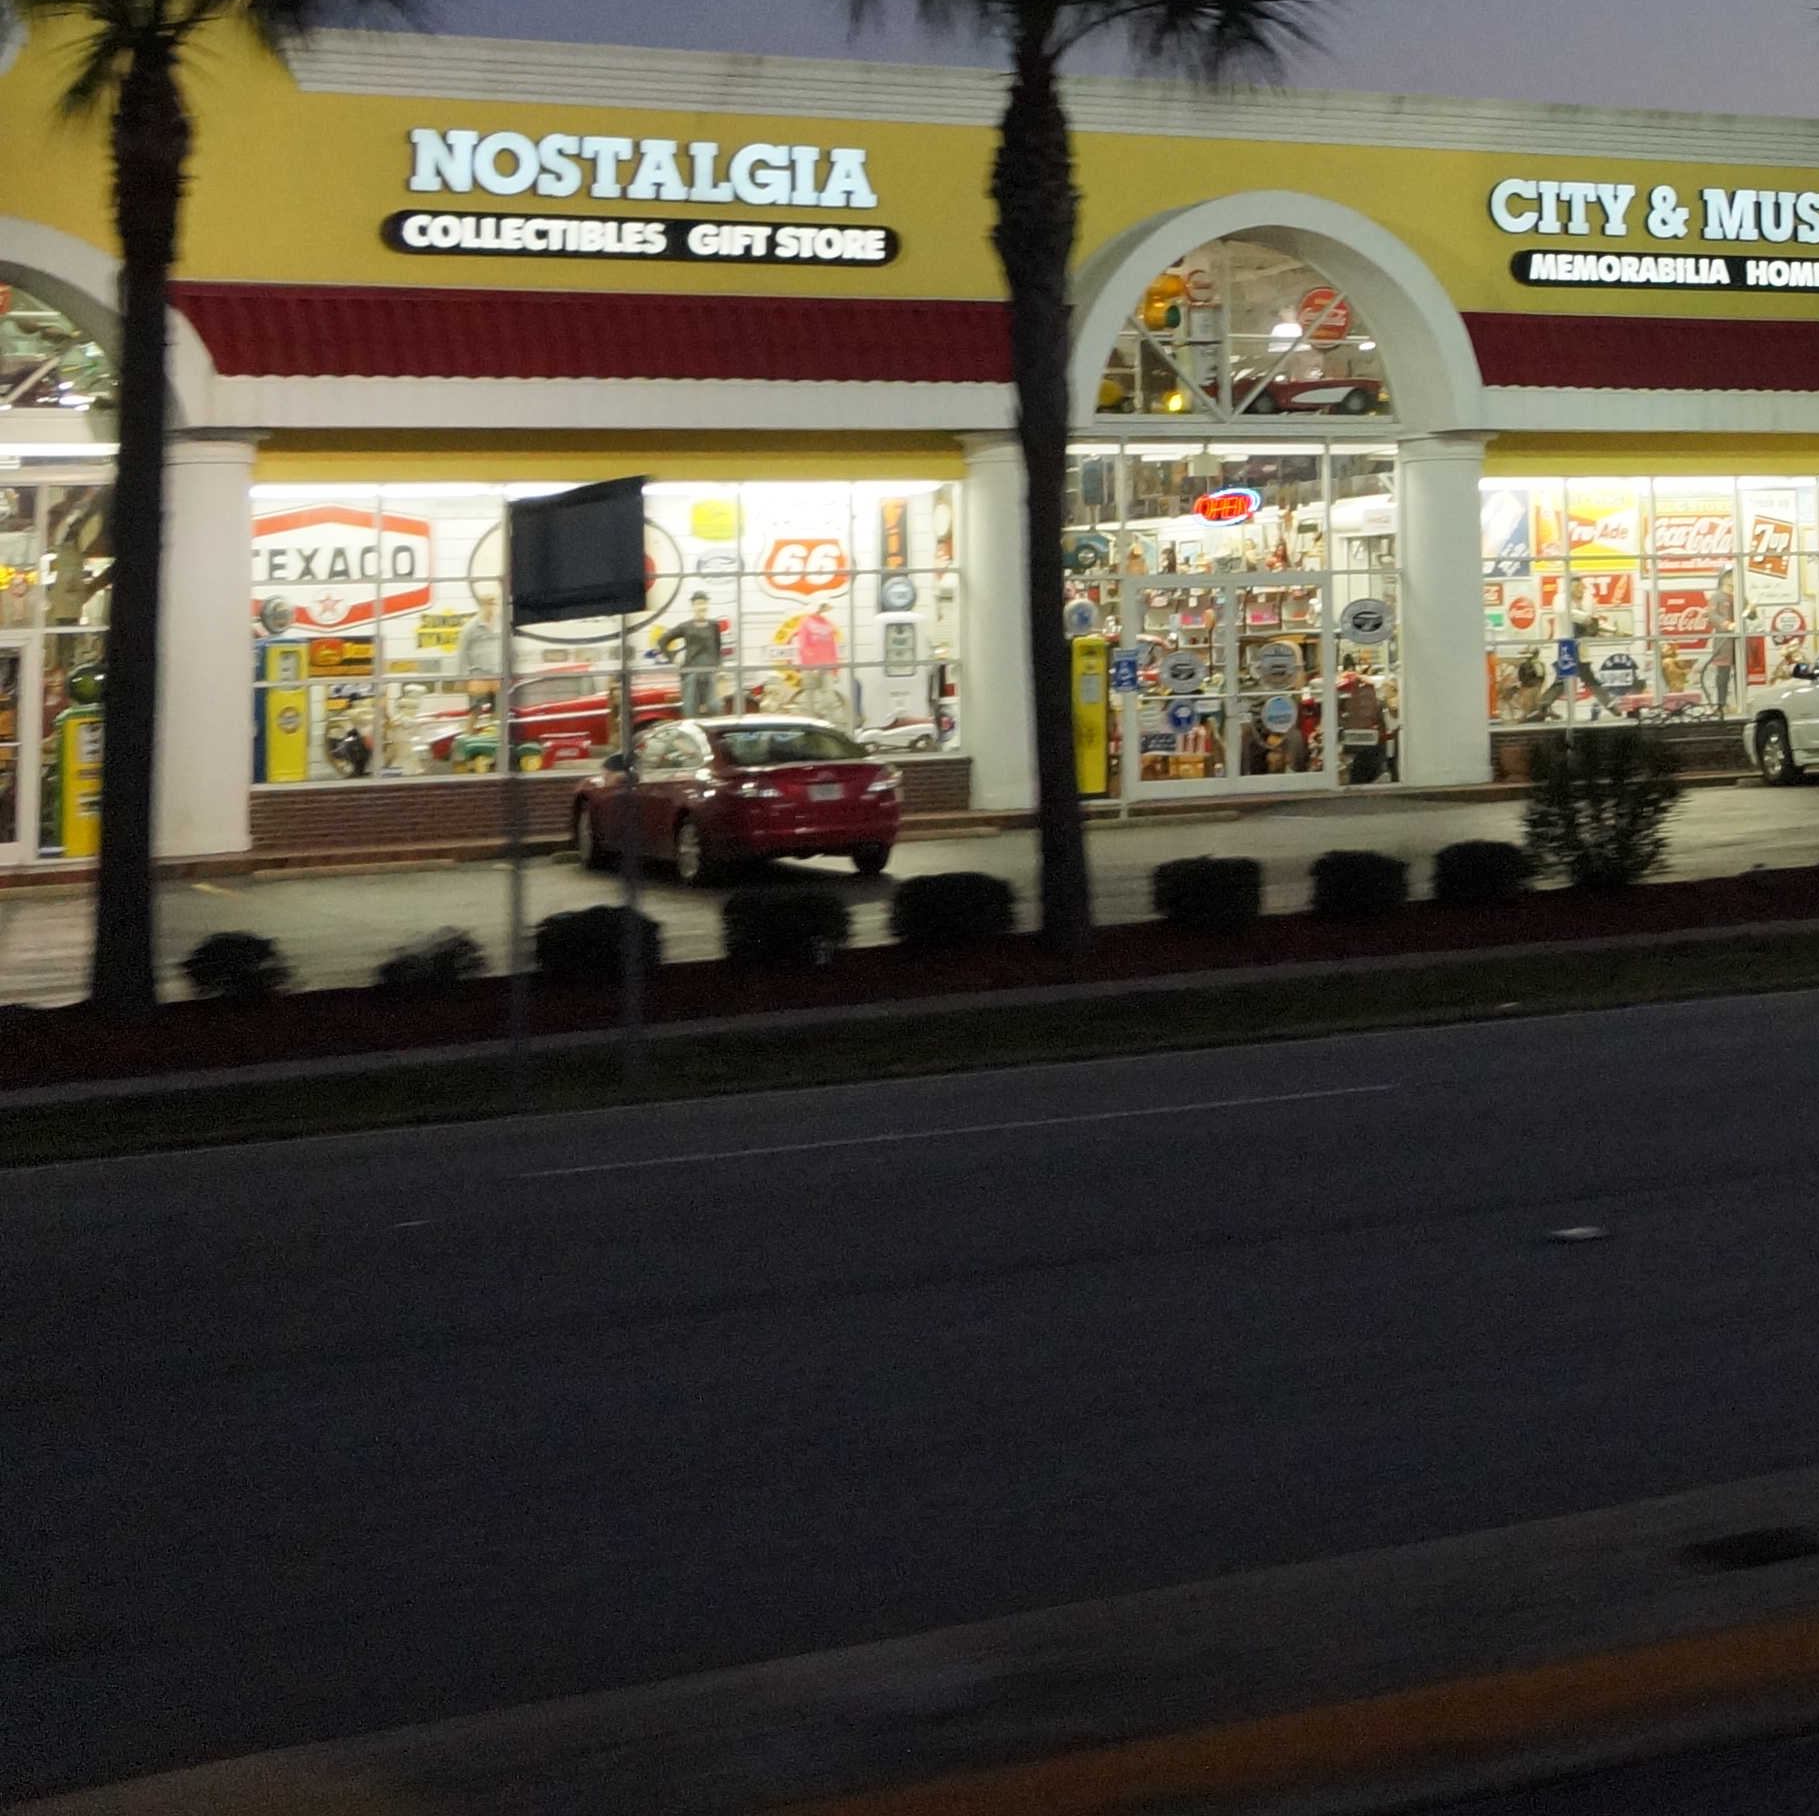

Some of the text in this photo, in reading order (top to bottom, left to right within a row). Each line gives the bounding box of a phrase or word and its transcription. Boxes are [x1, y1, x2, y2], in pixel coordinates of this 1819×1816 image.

[409, 128, 878, 208] NOSTALGIA
[1491, 178, 1636, 236] CITY
[1647, 185, 1690, 239] &
[402, 215, 885, 260] COLLECTIBLES GIFT STORE
[1530, 253, 1730, 284] MEMORABILIA
[1194, 495, 1252, 520] OPEN
[252, 545, 415, 581] EXACO
[771, 543, 840, 585] 66
